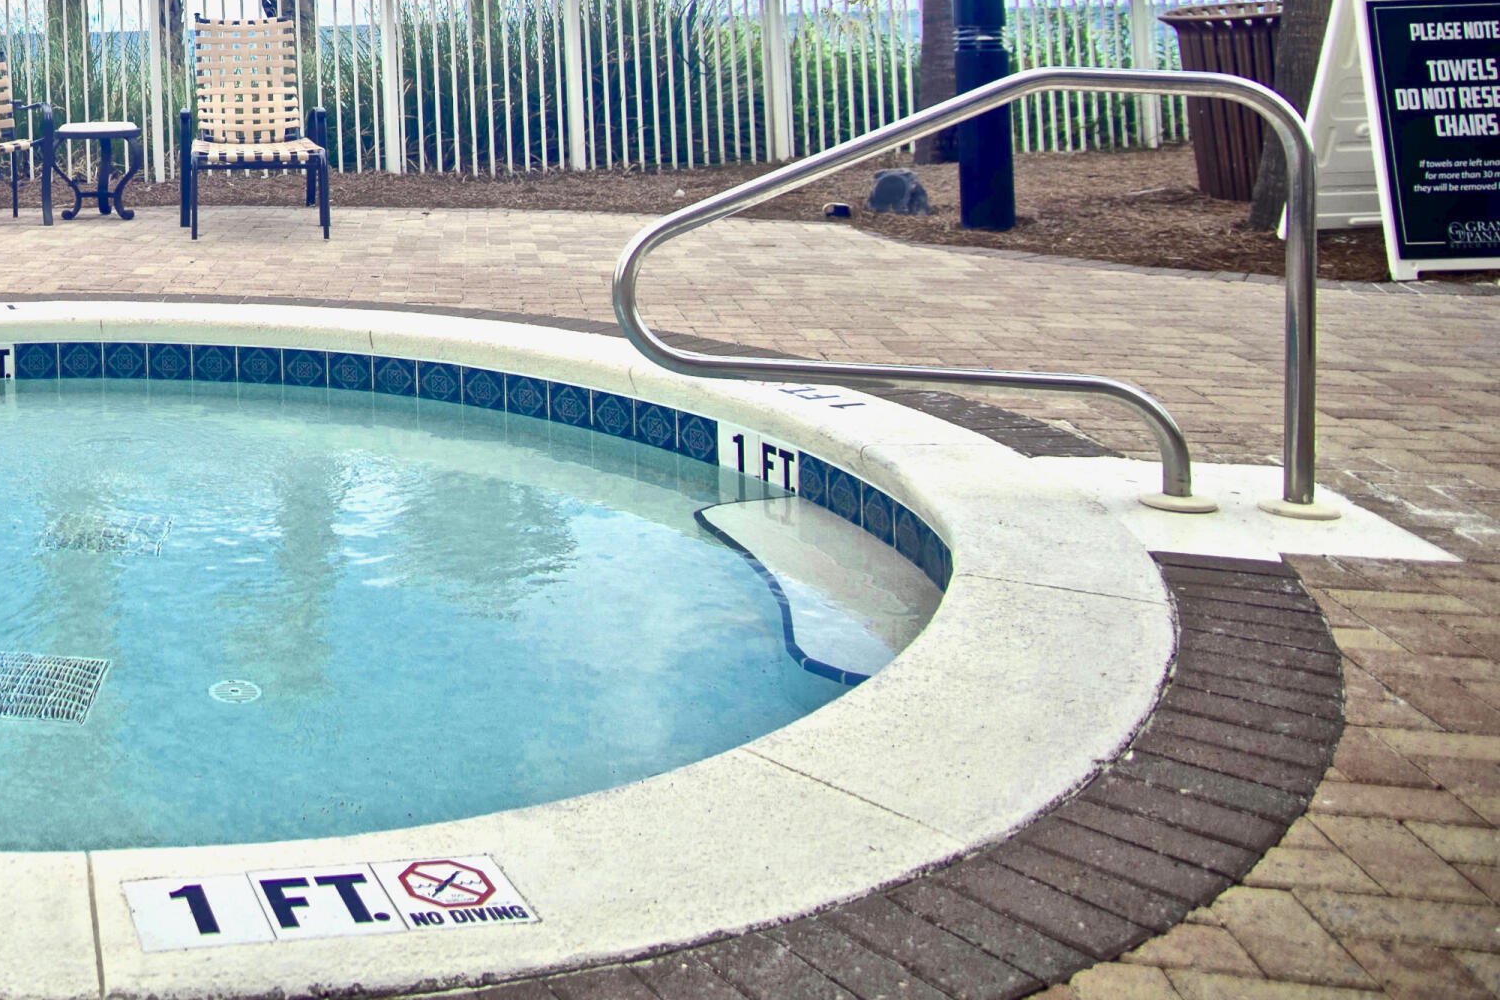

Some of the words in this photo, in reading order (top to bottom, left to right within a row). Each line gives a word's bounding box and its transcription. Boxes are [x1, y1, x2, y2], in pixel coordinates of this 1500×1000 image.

[1409, 22, 1463, 41] PLEASE
[1426, 58, 1499, 82] TOWELS
[1395, 88, 1421, 111] DO
[1421, 87, 1456, 110] NOT
[1434, 113, 1500, 137] CHAIRS
[1419, 160, 1426, 168] If
[1426, 159, 1453, 168] towels
[1468, 158, 1483, 167] left
[1424, 171, 1437, 180] for
[1461, 170, 1481, 179] than
[1483, 170, 1493, 178] 30
[1413, 183, 1432, 194] they
[1432, 183, 1448, 192] will
[1448, 182, 1459, 192] be
[1460, 181, 1498, 191] removed
[732, 433, 745, 473] 1
[762, 442, 796, 493] FT.
[169, 883, 221, 935] 1
[259, 873, 391, 929] FT.
[409, 911, 445, 927] NO
[448, 905, 529, 924] DIVING
